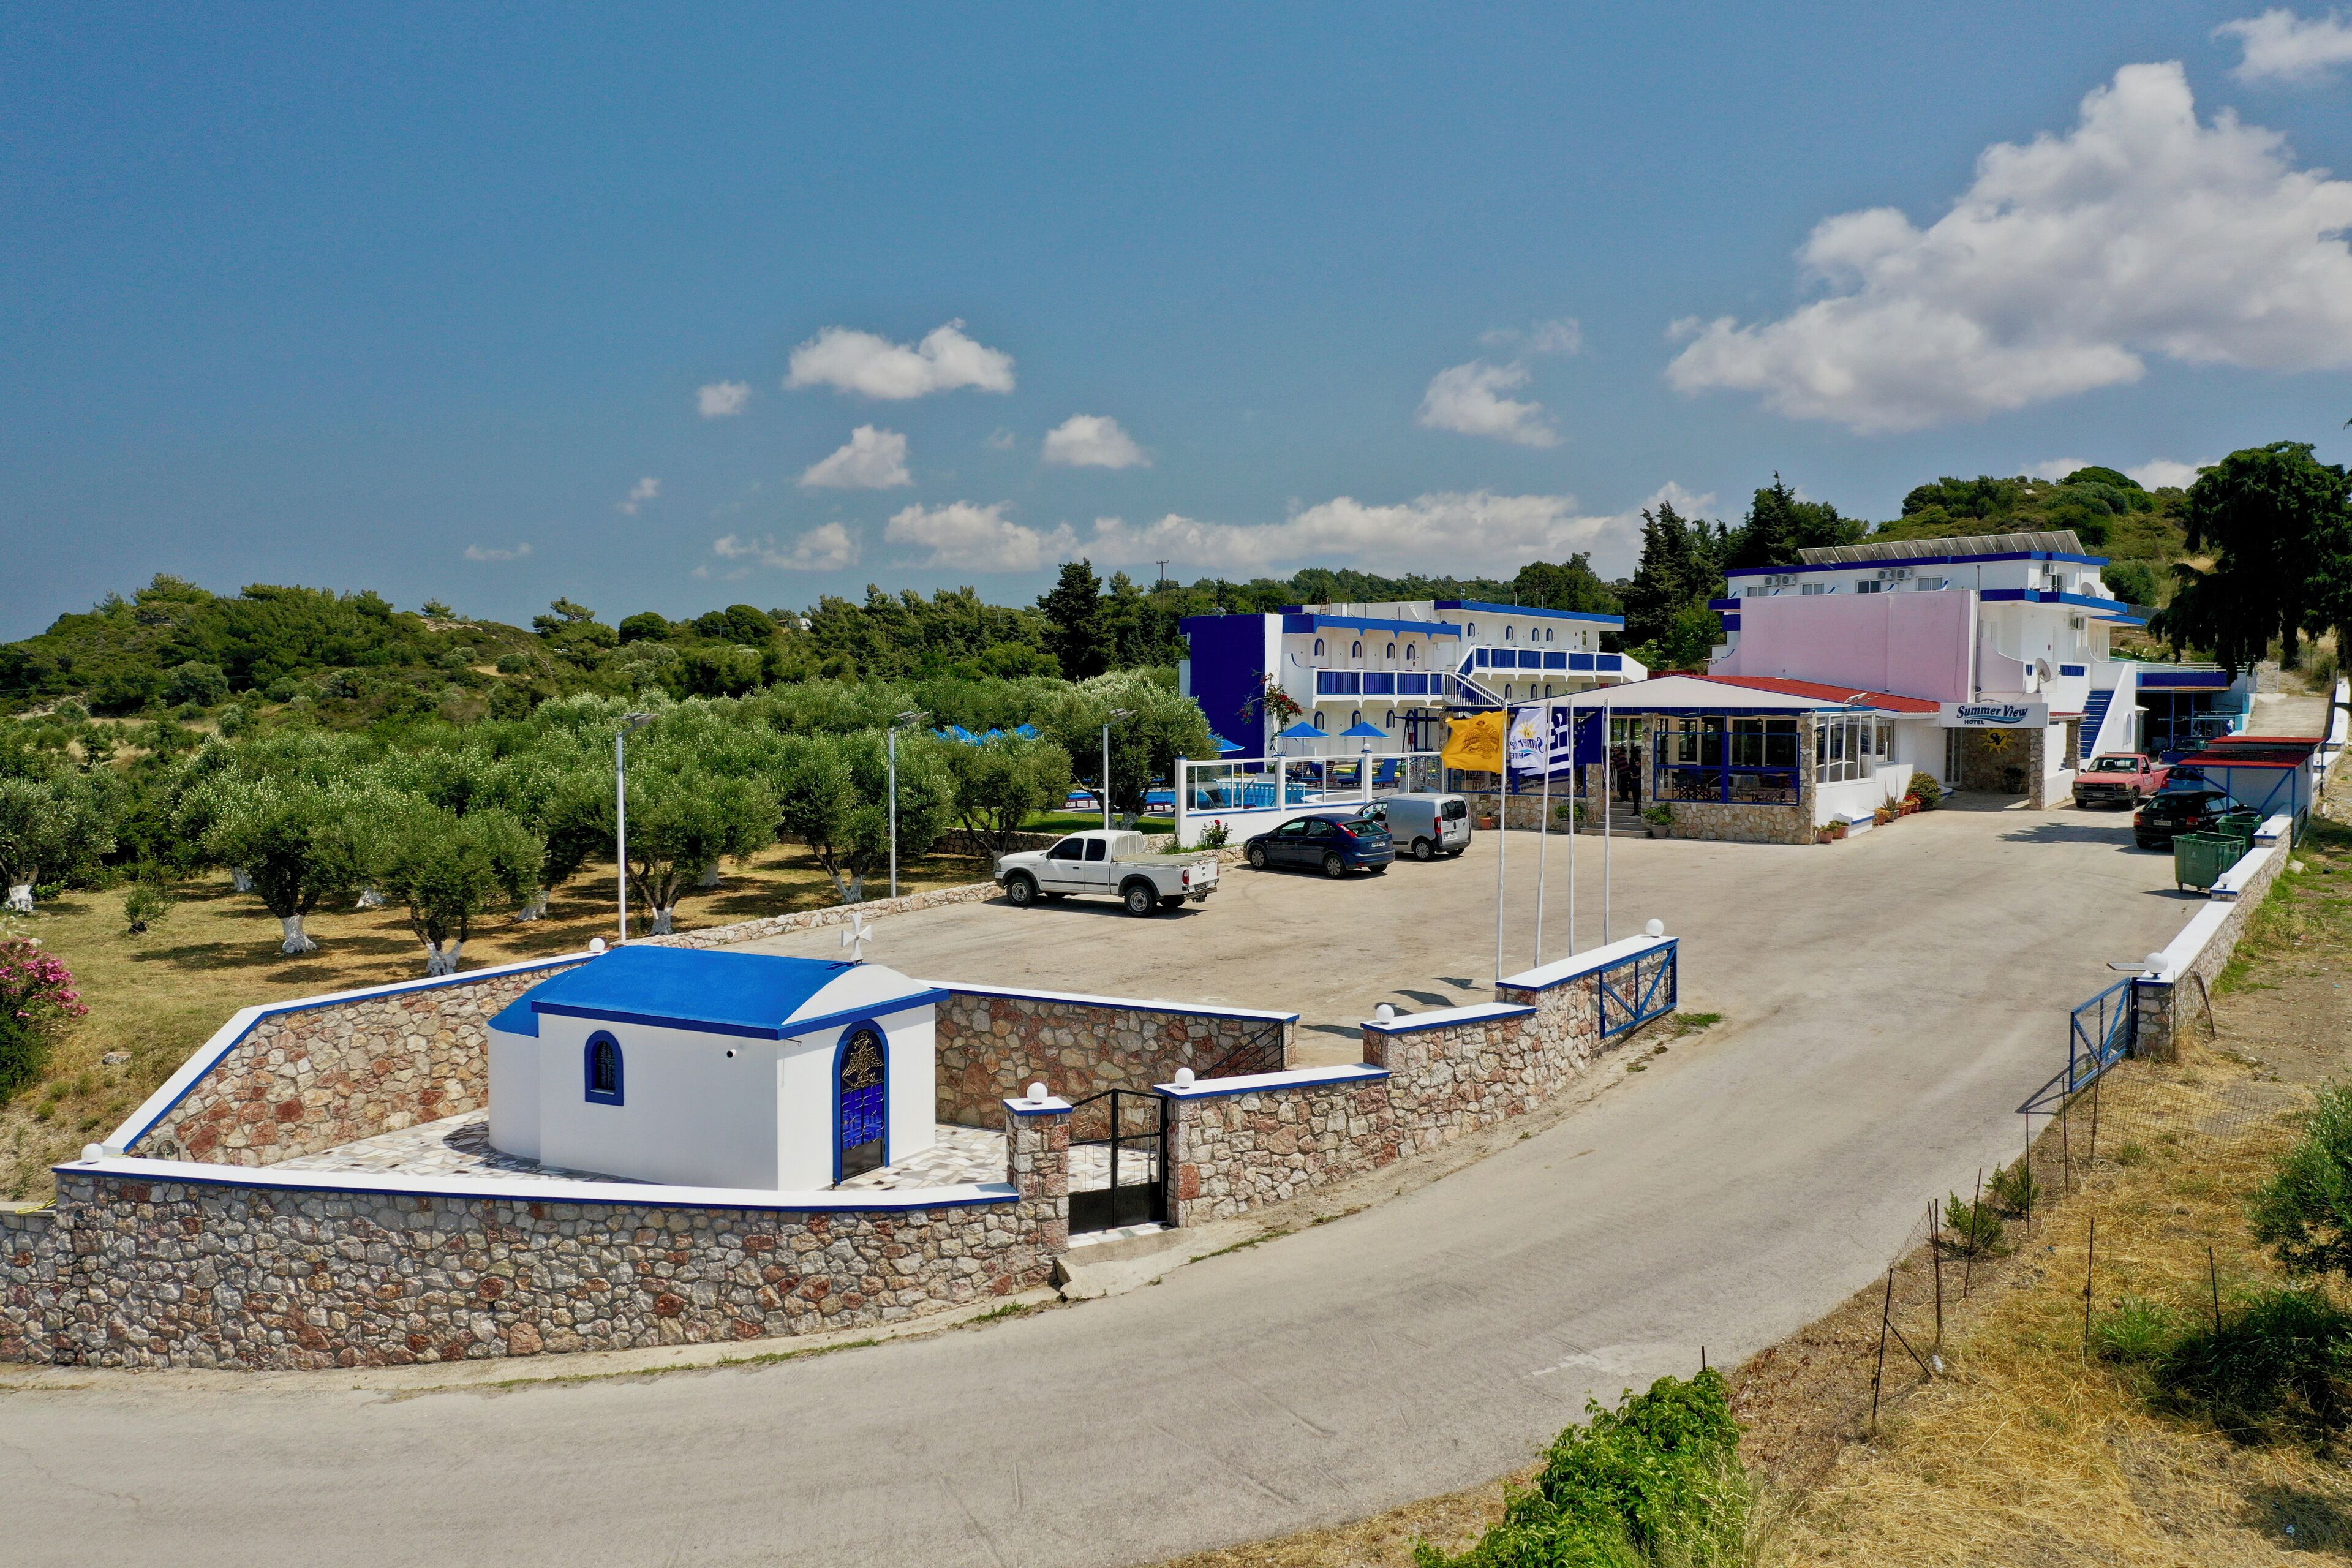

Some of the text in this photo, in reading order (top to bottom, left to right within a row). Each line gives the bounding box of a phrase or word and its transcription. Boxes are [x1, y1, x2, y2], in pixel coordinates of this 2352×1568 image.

[1956, 705, 2028, 718] Summer View
[1988, 733, 2006, 745] SV
